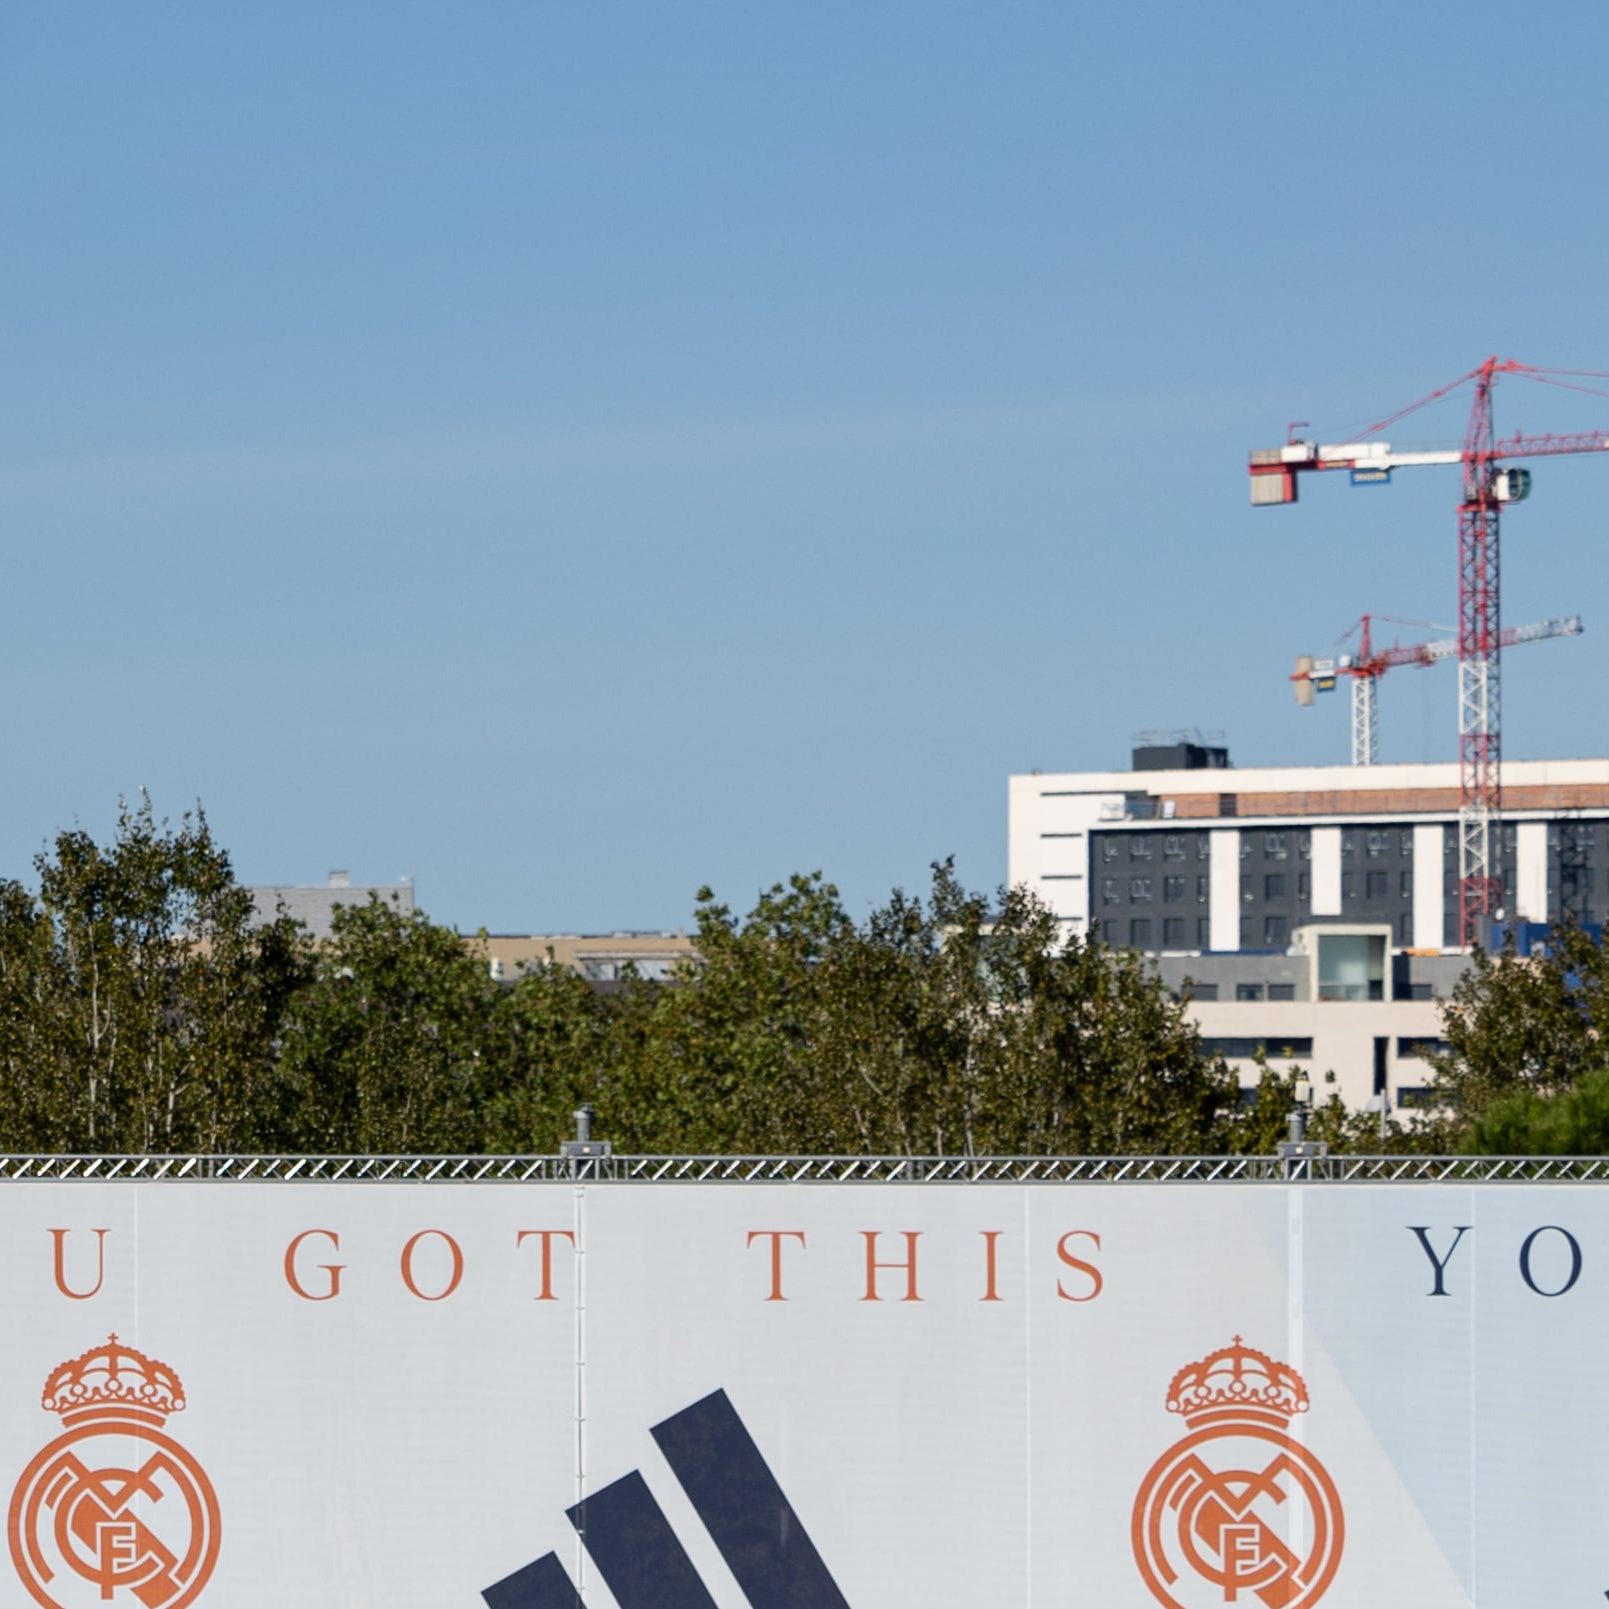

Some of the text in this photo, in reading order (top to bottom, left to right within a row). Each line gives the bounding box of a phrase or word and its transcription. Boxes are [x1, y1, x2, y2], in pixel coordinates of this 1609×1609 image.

[284, 1230, 576, 1302] GOT
[747, 1231, 1104, 1303] THIS
[1406, 1226, 1583, 1298] YO
